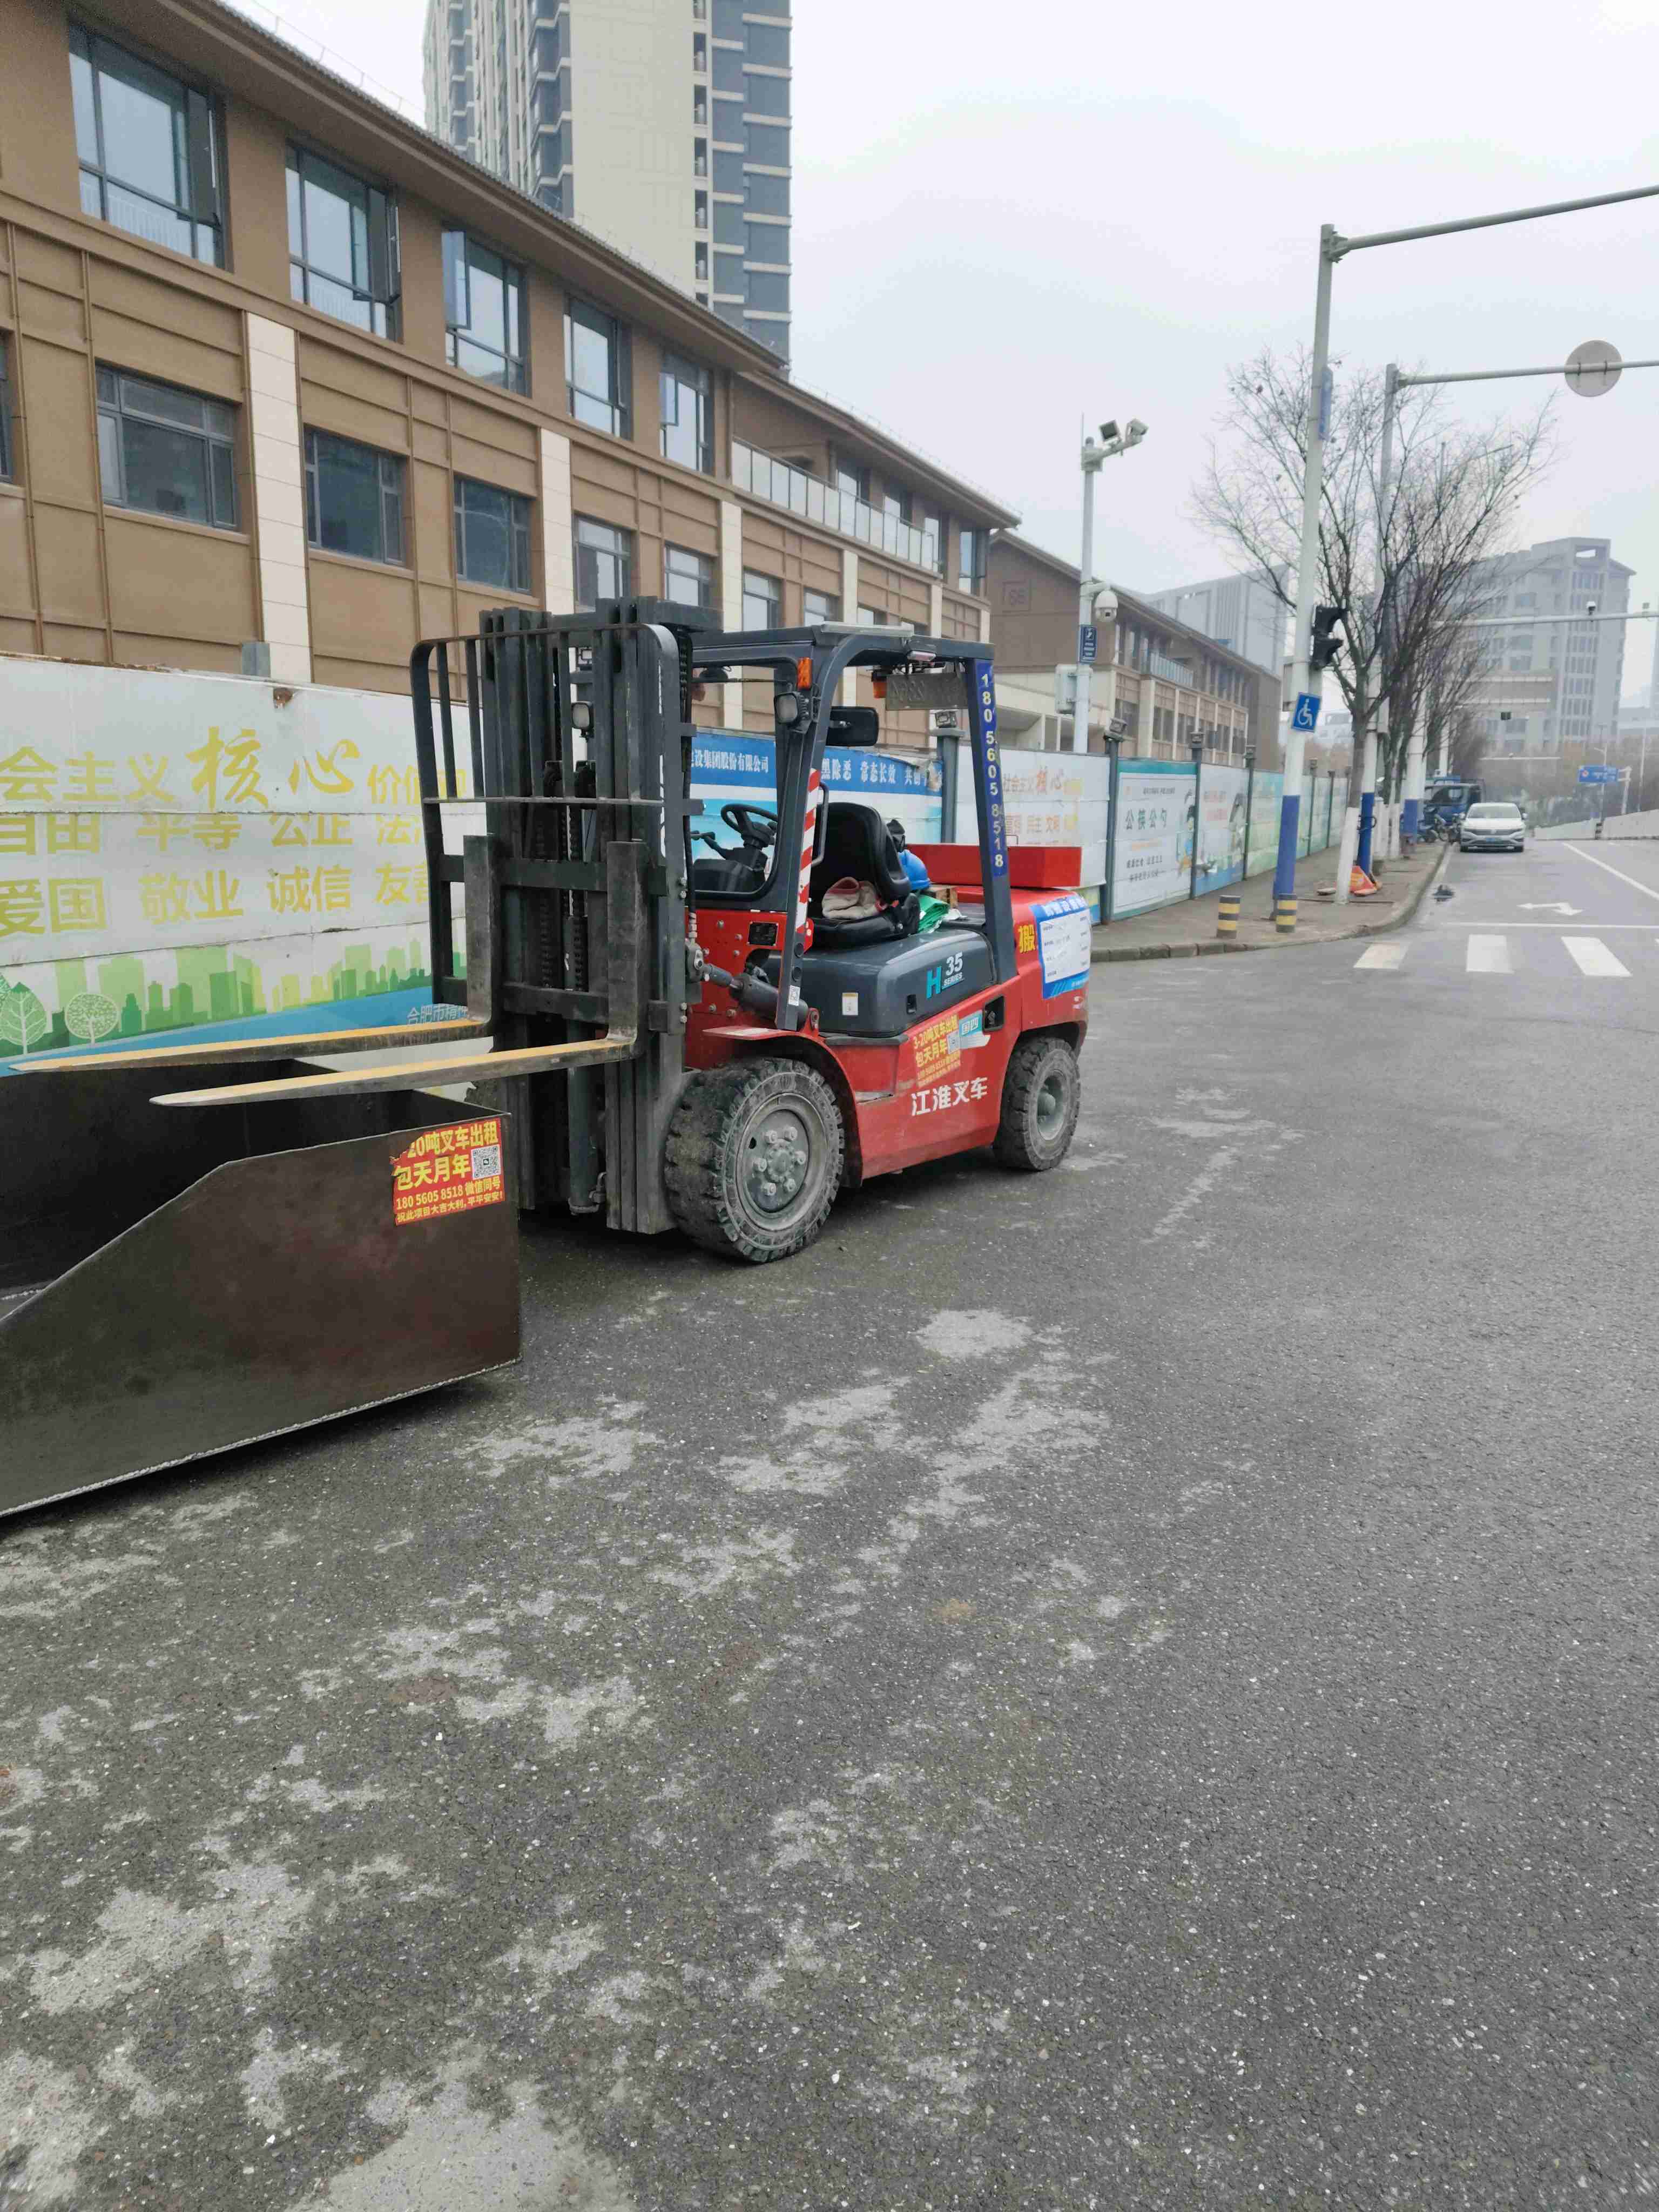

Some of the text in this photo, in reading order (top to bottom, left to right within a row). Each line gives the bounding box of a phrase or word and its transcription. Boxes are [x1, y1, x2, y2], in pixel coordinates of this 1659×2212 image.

[138, 869, 244, 925] 敬业
[267, 865, 351, 914] 诚信
[926, 951, 963, 999] H 35
[911, 1077, 988, 1117] 江淮叉车
[394, 1154, 471, 1191] 包天月年
[396, 1175, 501, 1211] 180 5605 8518 微信同号
